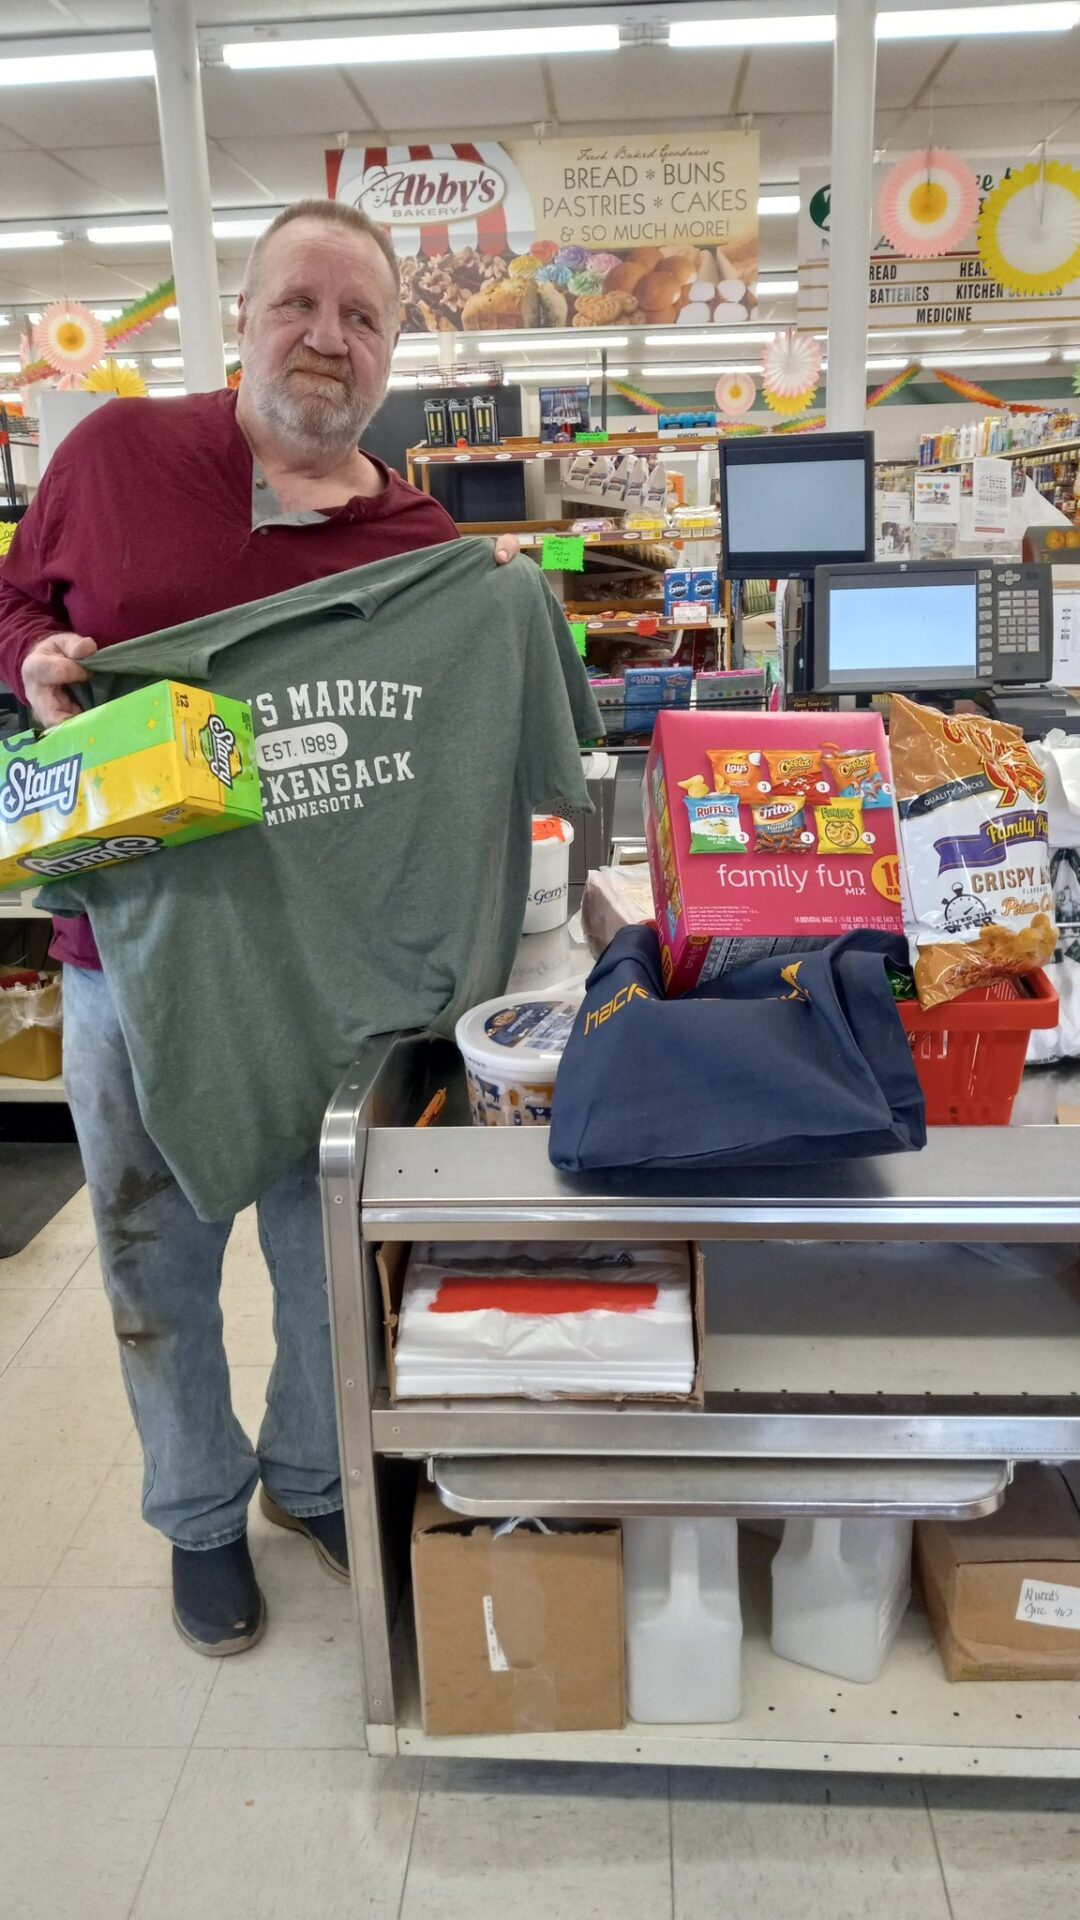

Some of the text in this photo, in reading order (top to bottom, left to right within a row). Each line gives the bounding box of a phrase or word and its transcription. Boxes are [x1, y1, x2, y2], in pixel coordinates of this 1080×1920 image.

[576, 144, 711, 163] Fresh Baked Goodness
[563, 160, 726, 190] BREAD BUNS
[389, 169, 497, 213] Abby's
[542, 188, 749, 219] PASTRIES CAKES
[392, 207, 459, 218] BAKERY
[560, 219, 730, 243] & SO MUCH MORE!
[870, 285, 930, 304] BATTERIES
[956, 282, 1004, 299] KITCHEN
[916, 306, 973, 324] MEDICINE
[179, 693, 189, 709] 12
[286, 679, 423, 722] MARKET
[209, 714, 234, 788] Starry
[261, 733, 338, 763] EST. 1989
[779, 756, 813, 774] Cheetos
[840, 758, 869, 776] Cheetos
[0, 756, 81, 820] Starry
[924, 779, 985, 806] QUALITY SNACKS
[264, 793, 365, 827] MINNESOTA
[696, 805, 734, 818] RUFFLES
[986, 816, 1035, 844] Family
[717, 864, 865, 893] family fun
[970, 866, 1035, 894] CRISPY
[845, 888, 867, 896] MIX
[943, 916, 997, 934] OFFER
